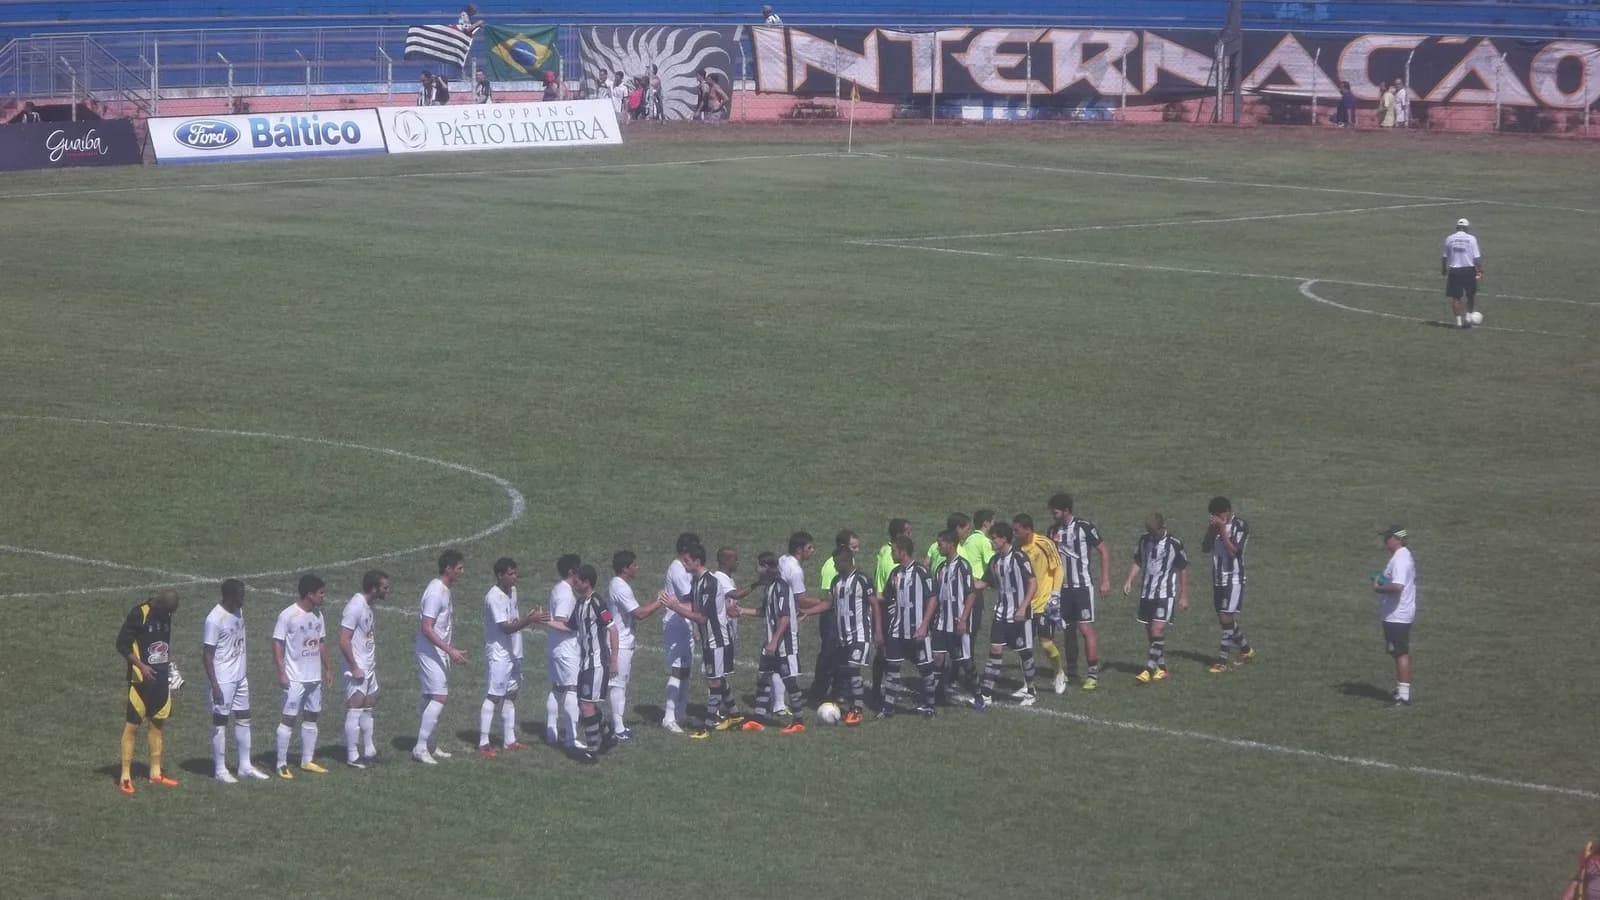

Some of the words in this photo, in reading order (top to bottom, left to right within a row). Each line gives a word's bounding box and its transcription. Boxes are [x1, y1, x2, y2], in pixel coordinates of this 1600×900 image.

[462, 105, 574, 120] SHOPPING
[188, 123, 227, 144] Ford
[247, 115, 361, 149] Báltico
[436, 117, 505, 146] PÁTIO
[507, 115, 609, 143] LIMEIRA
